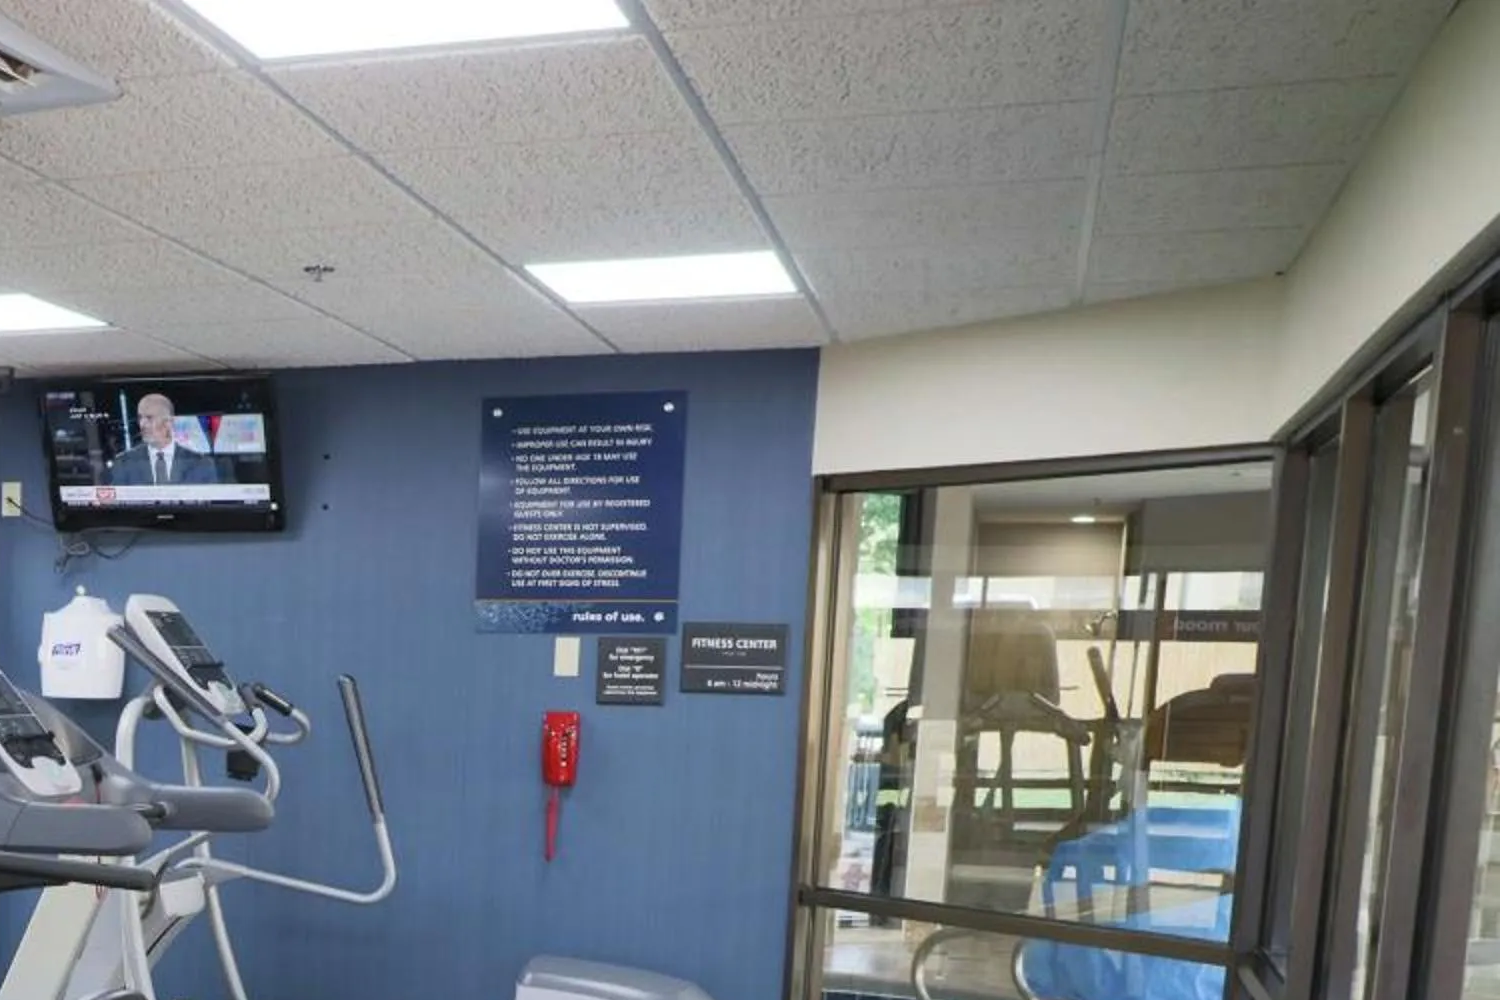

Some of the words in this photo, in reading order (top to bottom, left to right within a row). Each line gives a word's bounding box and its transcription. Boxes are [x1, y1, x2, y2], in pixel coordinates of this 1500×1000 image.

[573, 611, 602, 622] rules
[604, 611, 619, 622] of
[621, 613, 645, 622] use.
[692, 637, 734, 649] FITNESS
[735, 638, 777, 650] CENTER
[743, 680, 778, 690] midnight
